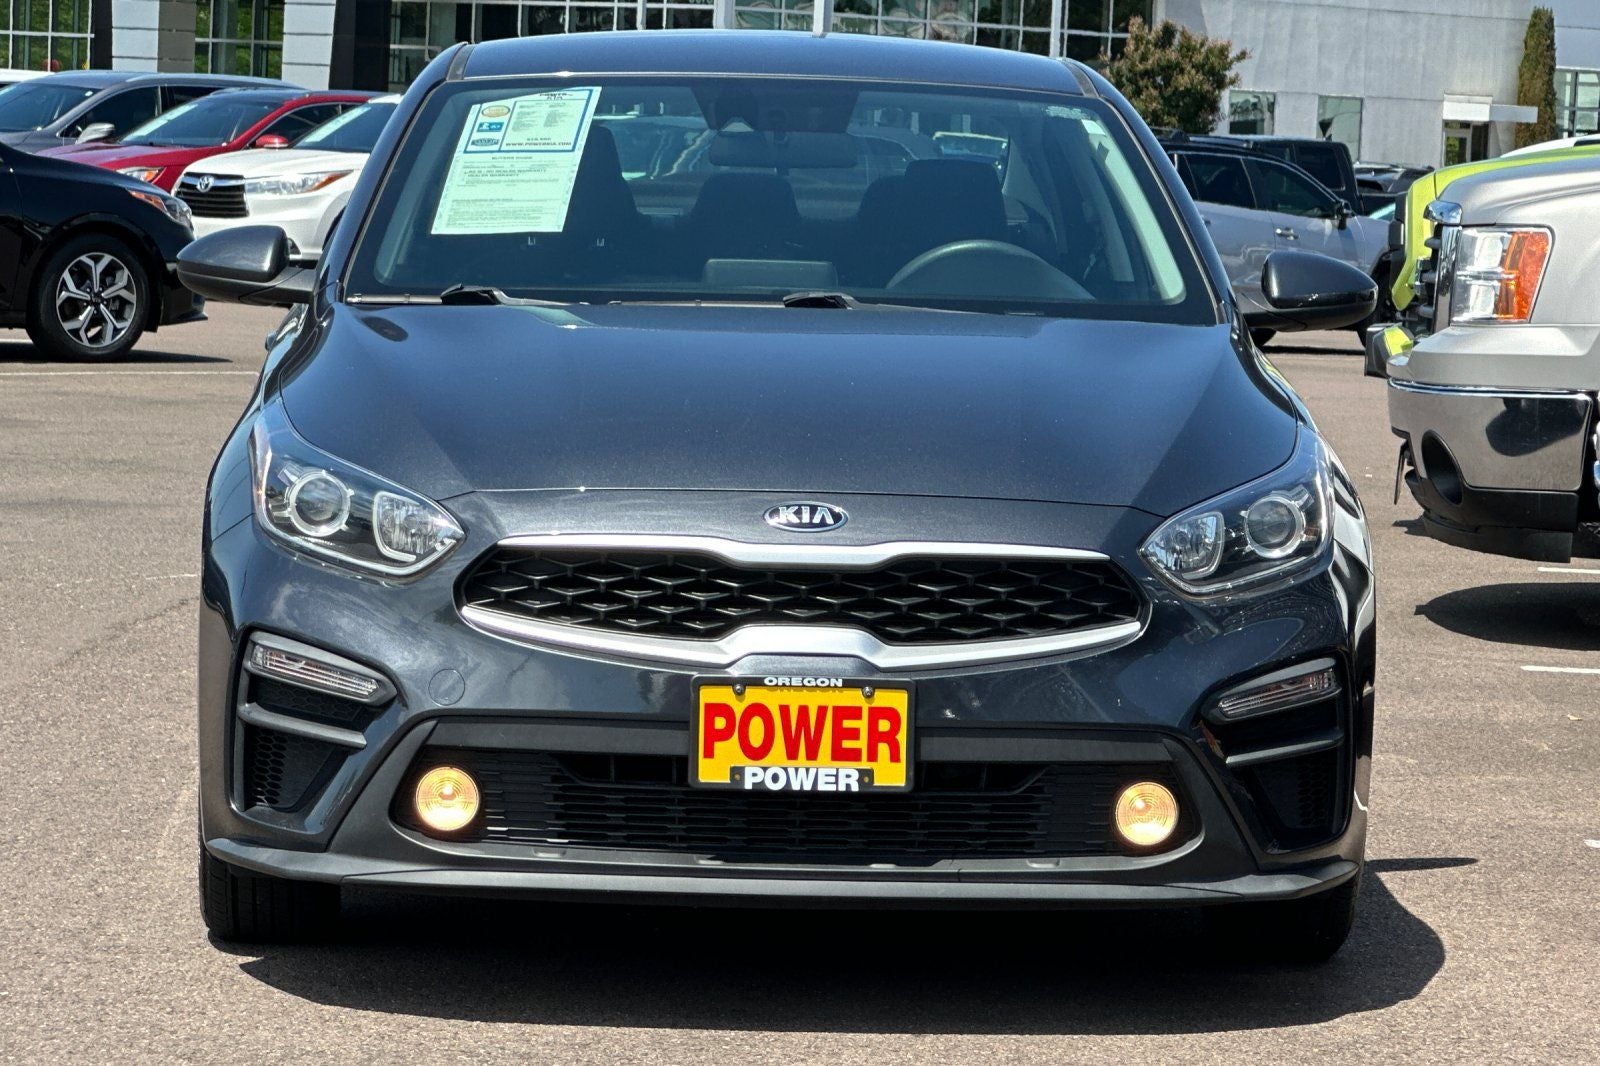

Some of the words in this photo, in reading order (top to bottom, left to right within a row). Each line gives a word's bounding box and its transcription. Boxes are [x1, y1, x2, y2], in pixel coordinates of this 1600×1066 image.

[778, 505, 835, 525] KIA
[763, 676, 843, 687] OREGON
[703, 702, 902, 763] POWER
[744, 766, 860, 792] POWER
